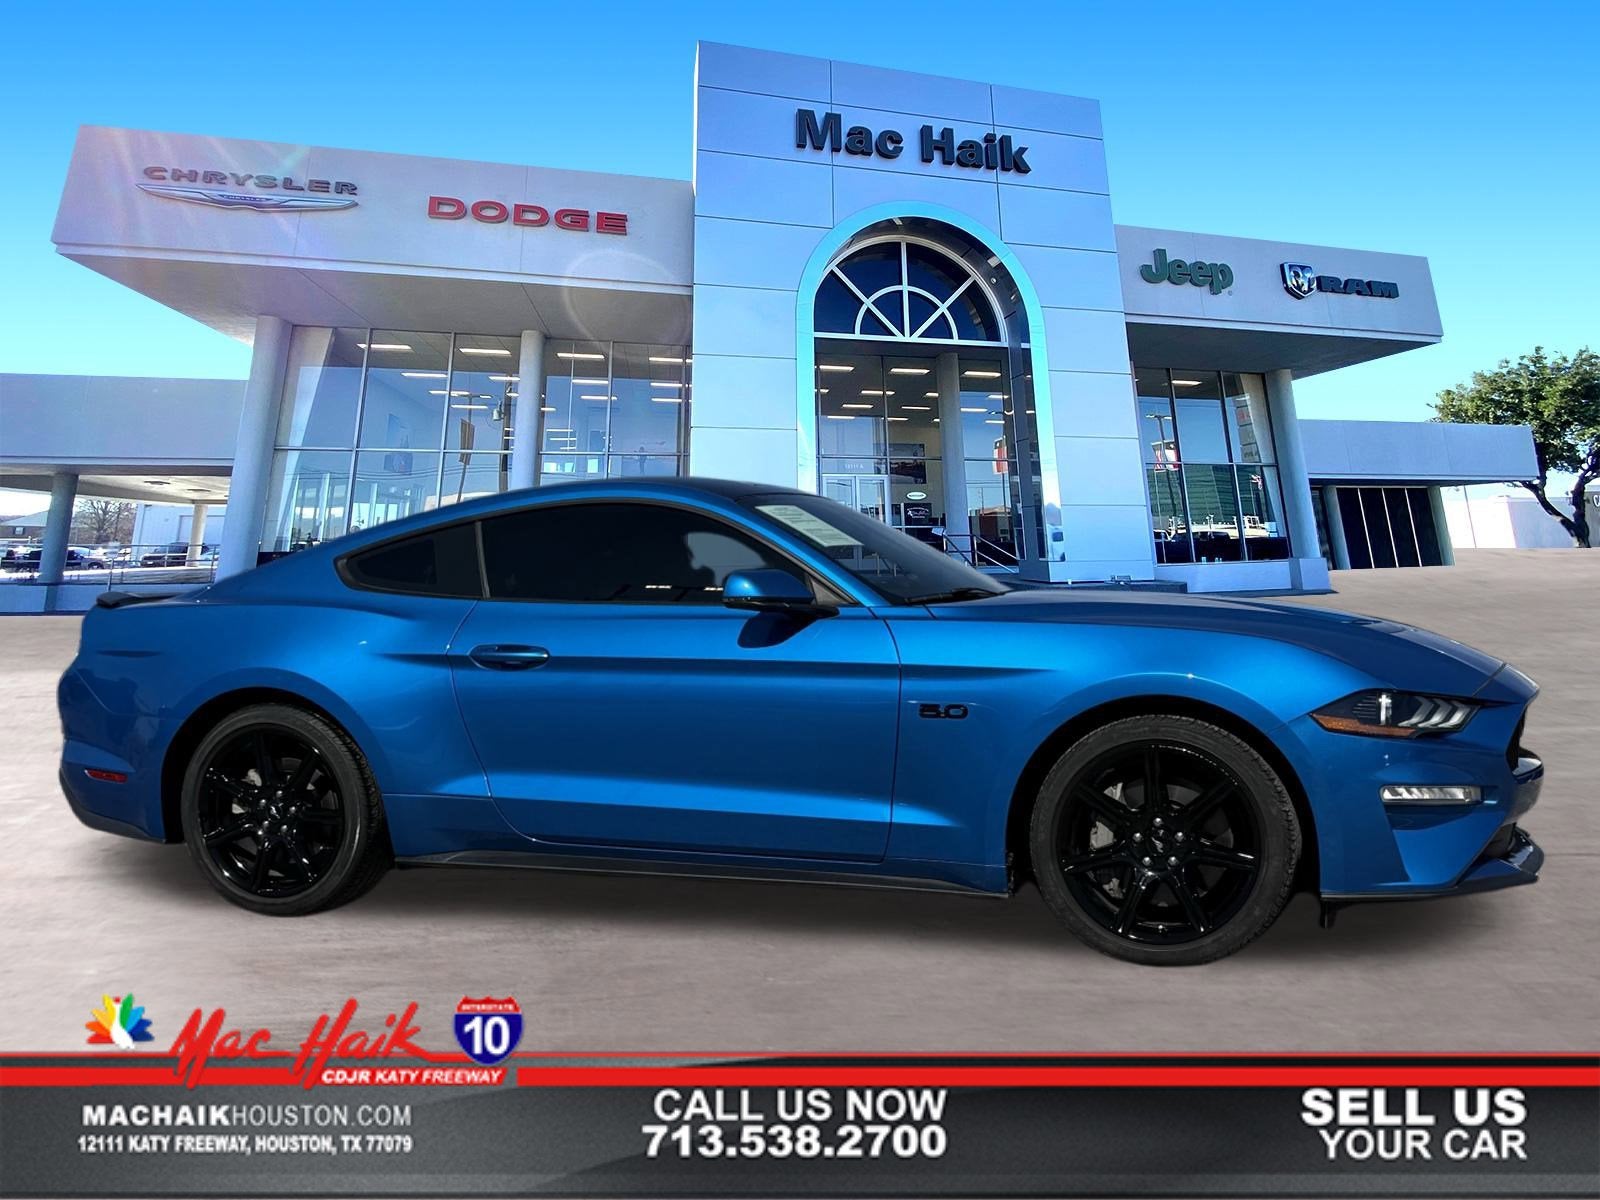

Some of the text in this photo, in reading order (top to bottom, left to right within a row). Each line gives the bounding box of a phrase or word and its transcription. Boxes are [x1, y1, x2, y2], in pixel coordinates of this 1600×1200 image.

[796, 108, 1032, 174] Mac Haik
[143, 166, 358, 196] CHRYSLER
[428, 196, 628, 236] DODGE
[1140, 248, 1234, 295] Jeep
[1316, 275, 1399, 299] RAM
[919, 703, 968, 720] 5.0
